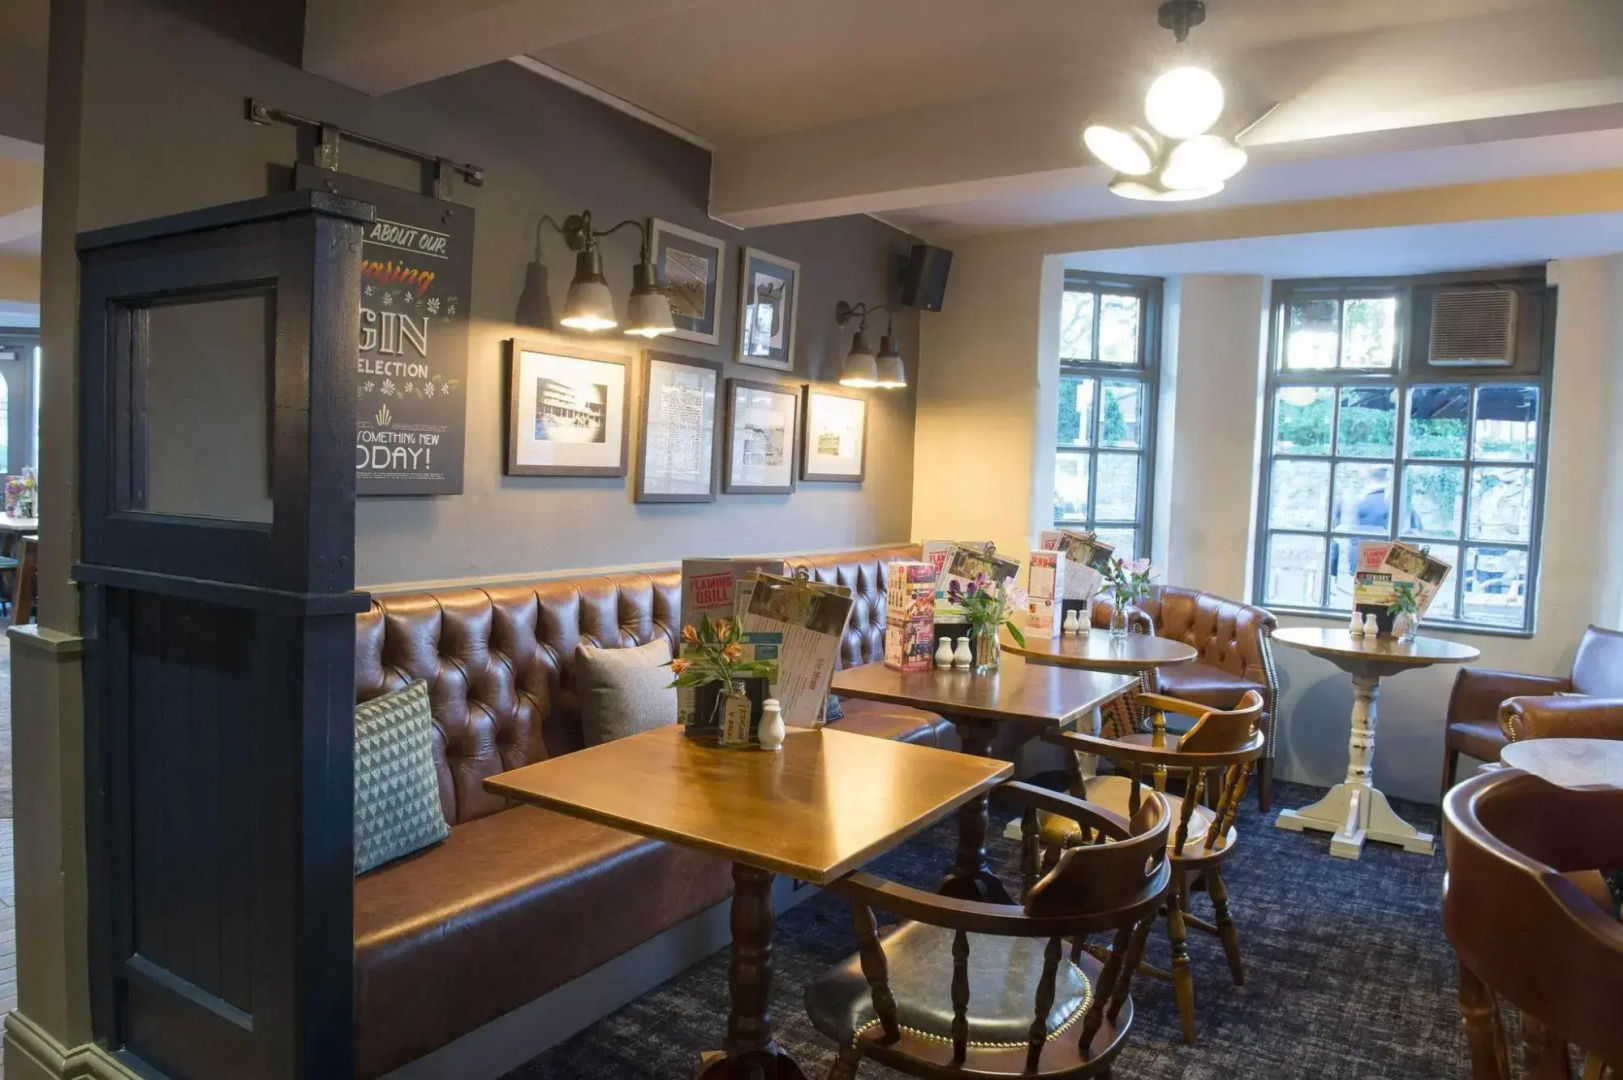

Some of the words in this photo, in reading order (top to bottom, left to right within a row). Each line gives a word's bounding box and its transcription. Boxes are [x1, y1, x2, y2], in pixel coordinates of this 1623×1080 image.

[370, 223, 418, 247] ABOUT
[419, 234, 447, 254] OUR
[360, 260, 435, 298] azing
[359, 307, 430, 356] GIN
[357, 358, 428, 378] ELECTION
[419, 433, 440, 445] NEW
[356, 444, 431, 470] ODAY!
[690, 576, 731, 591] FLAMING
[696, 589, 730, 603] GRILL
